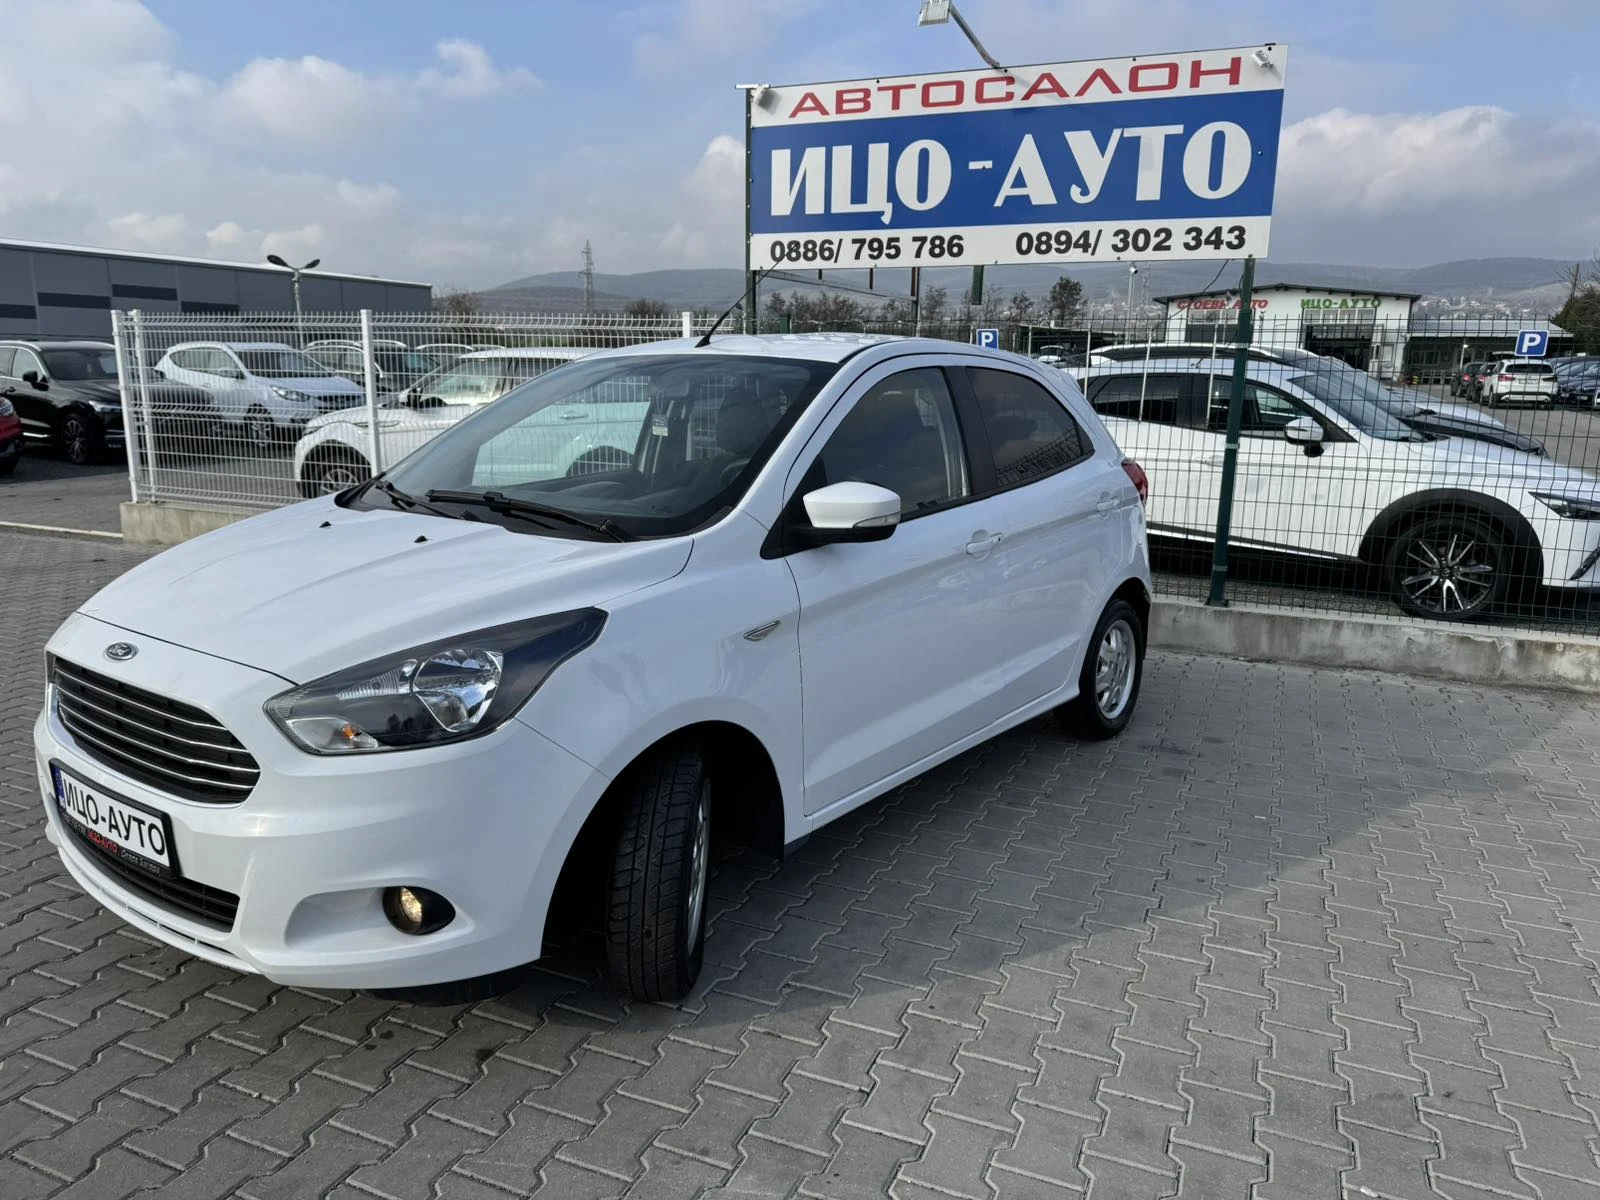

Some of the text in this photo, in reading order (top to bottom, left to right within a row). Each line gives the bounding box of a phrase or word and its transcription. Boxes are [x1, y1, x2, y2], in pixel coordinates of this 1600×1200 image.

[788, 56, 1242, 119] АВТОСАЛОН
[770, 234, 965, 264] 0886/ 795 786
[1015, 225, 1247, 256] 0894/ 302 343
[1231, 299, 1269, 310] АТО
[1300, 298, 1382, 310] ИЦО-АУТО
[981, 331, 994, 349] P
[1521, 333, 1542, 353] P
[63, 778, 166, 856] ИЦО-АУТО
